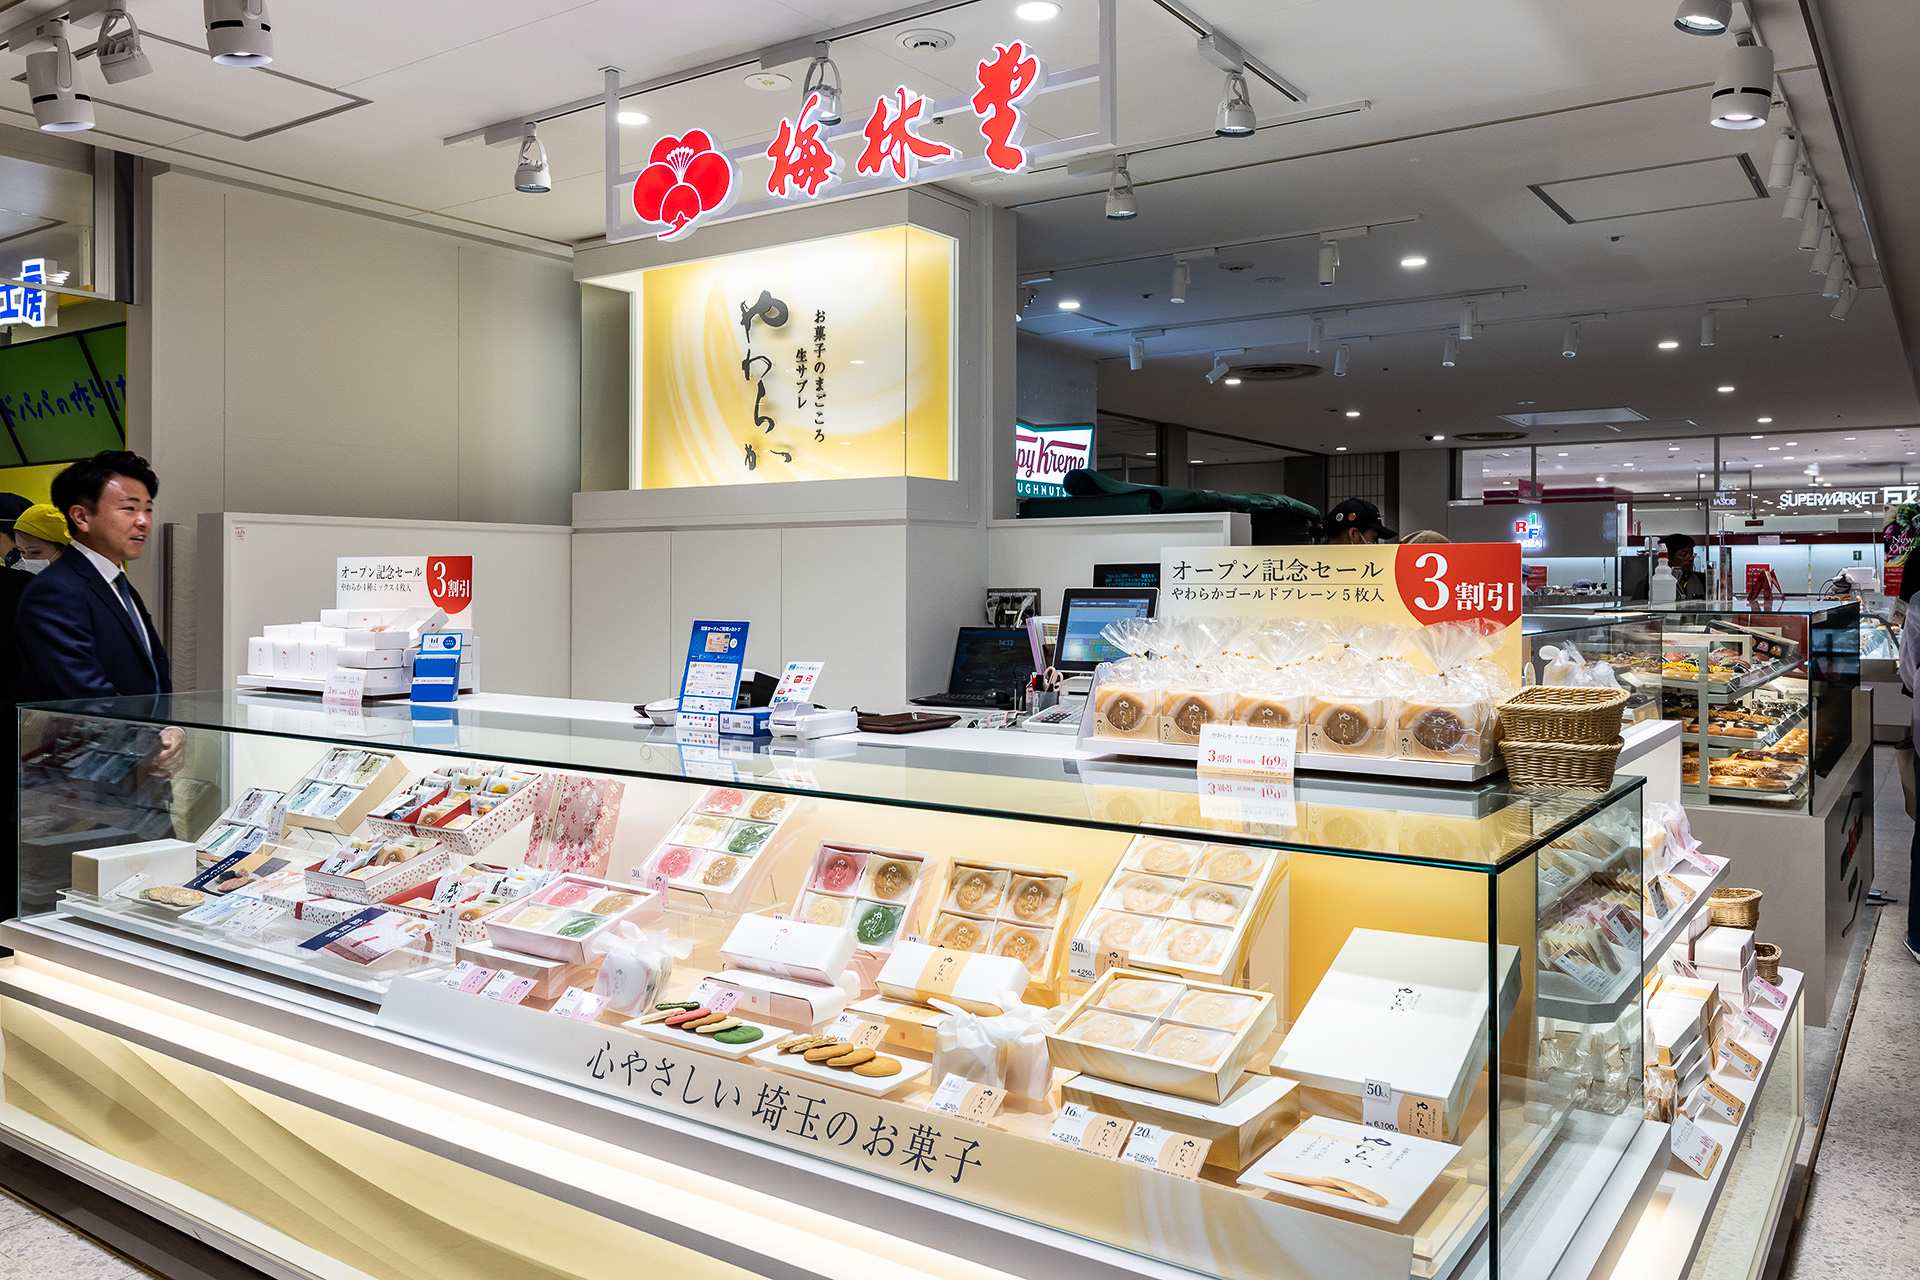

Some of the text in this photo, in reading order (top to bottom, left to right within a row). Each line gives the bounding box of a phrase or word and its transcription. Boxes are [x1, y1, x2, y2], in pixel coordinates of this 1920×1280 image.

[767, 39, 1043, 199] 梅林堂
[740, 290, 792, 470] やわらか
[795, 348, 808, 409] 生サブレ
[813, 309, 827, 443] お菓子のまごころ
[1779, 491, 1879, 507] SUPERMARKET
[341, 565, 423, 580] オープン記念セール
[432, 561, 470, 598] 3割引
[1172, 558, 1385, 582] オープン記念セール
[1413, 552, 1514, 611] 3割引
